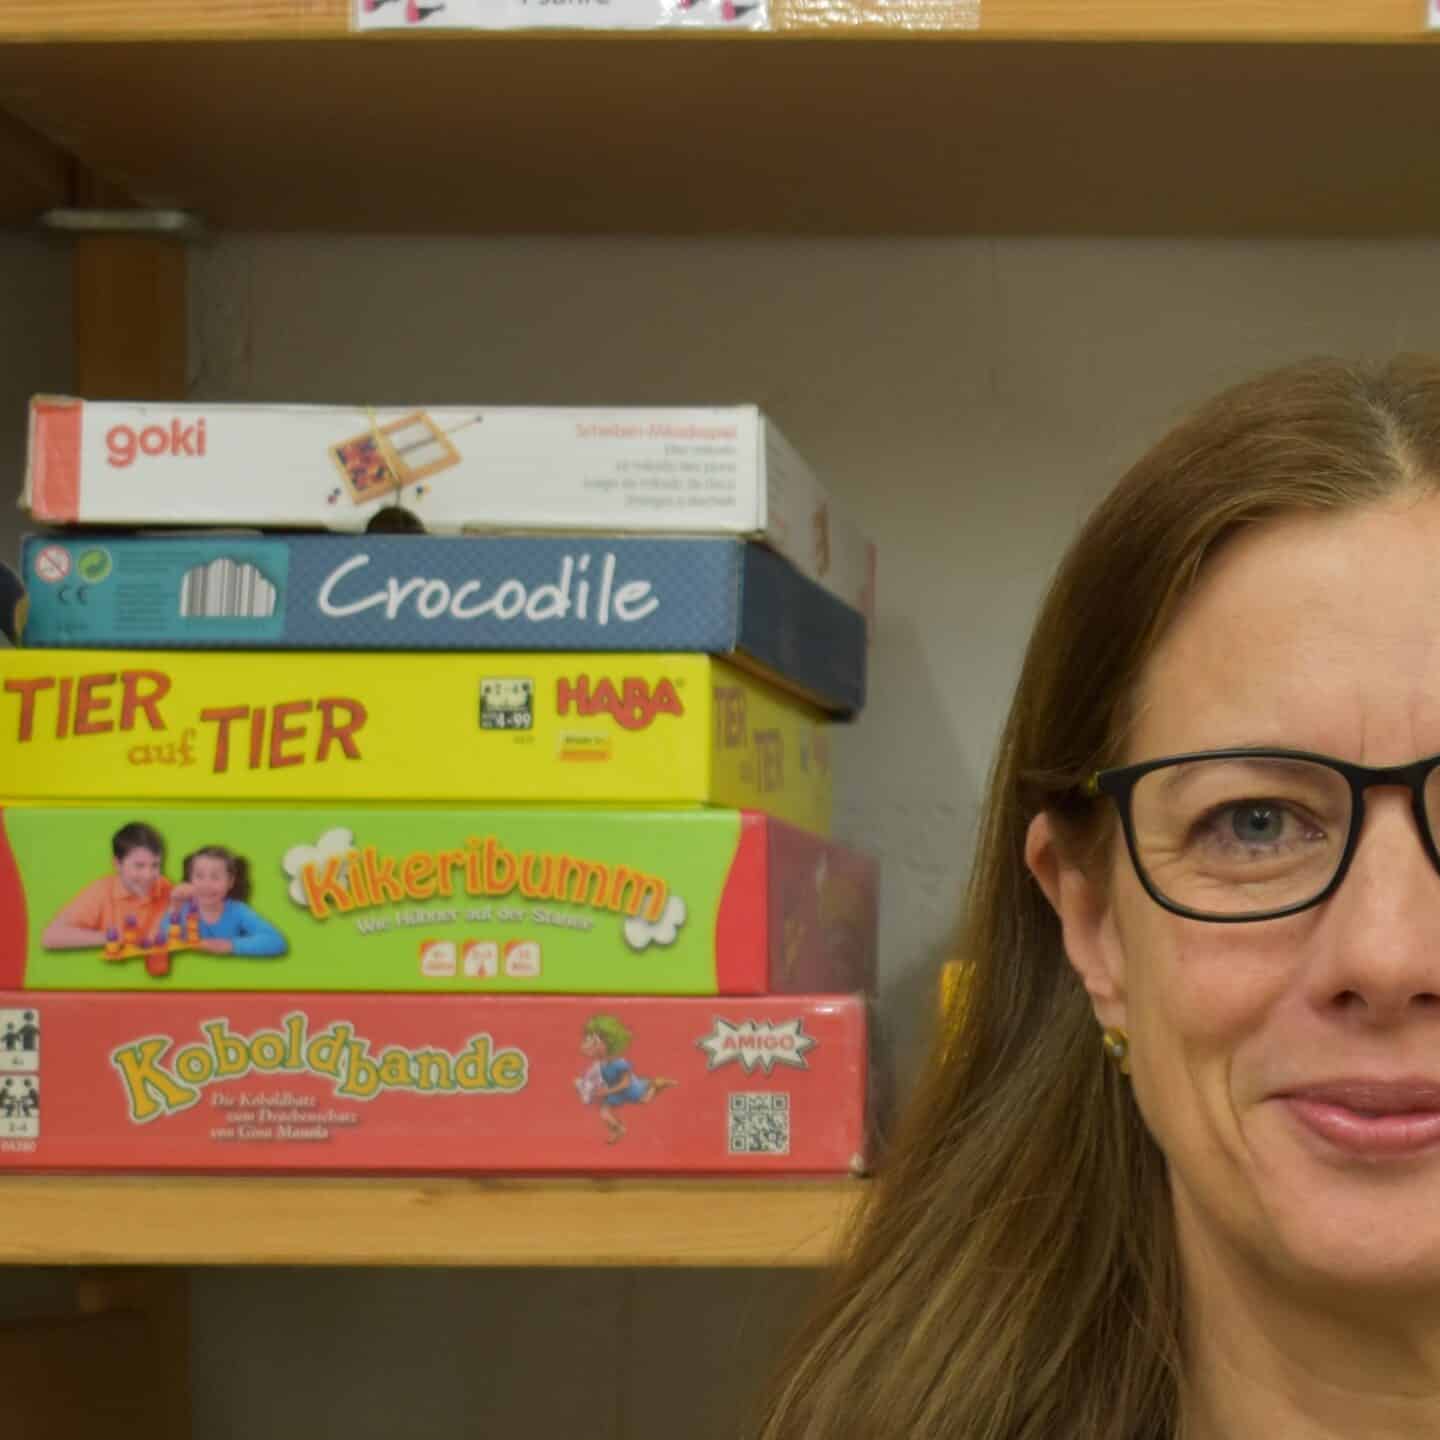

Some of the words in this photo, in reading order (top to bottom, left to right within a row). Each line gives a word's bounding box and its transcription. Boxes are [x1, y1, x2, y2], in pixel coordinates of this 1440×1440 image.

[105, 418, 207, 468] goki
[317, 554, 660, 626] Crocodile
[3, 669, 172, 745] TIER
[201, 697, 369, 774] TIER
[556, 673, 685, 731] HABA
[127, 735, 201, 769] auf
[301, 835, 668, 921] Kikeribumm
[110, 1010, 528, 1125] Koboldbande
[721, 1033, 796, 1053] AMIGO
